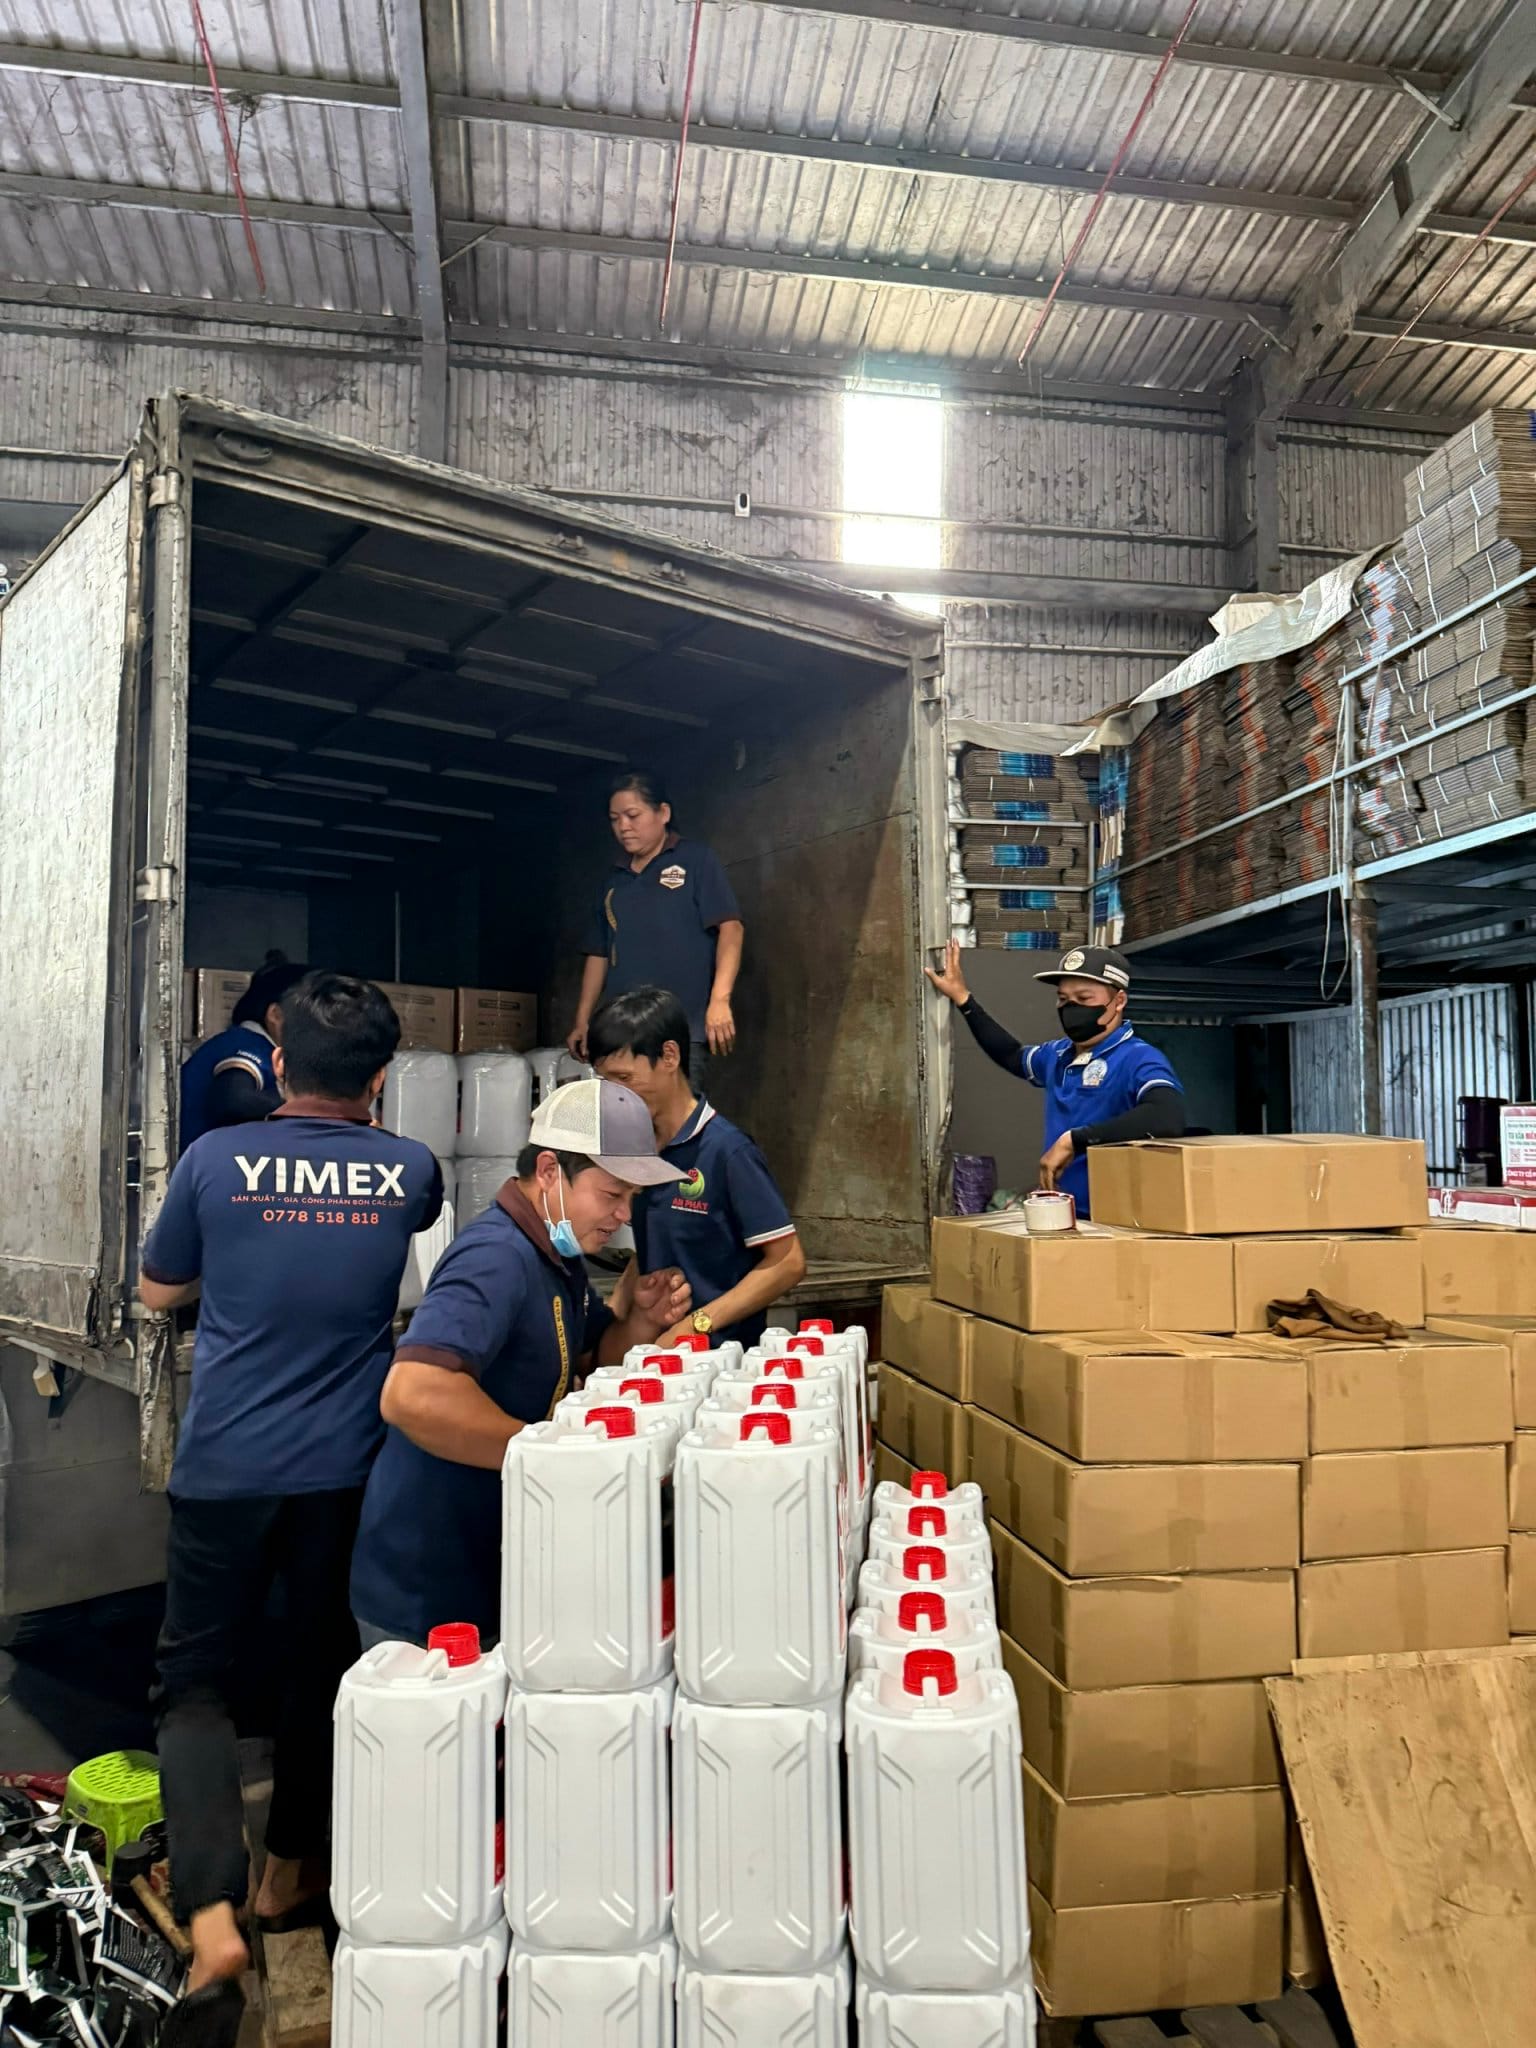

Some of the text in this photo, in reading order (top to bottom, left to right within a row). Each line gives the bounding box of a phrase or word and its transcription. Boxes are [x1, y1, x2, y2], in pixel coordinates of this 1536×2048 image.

[233, 1155, 406, 1198] YIMEX
[251, 1193, 275, 1202] XUẤT
[283, 1196, 298, 1204] GIA
[301, 1196, 325, 1204] CÔNG
[263, 1209, 379, 1225] 0778 518 818
